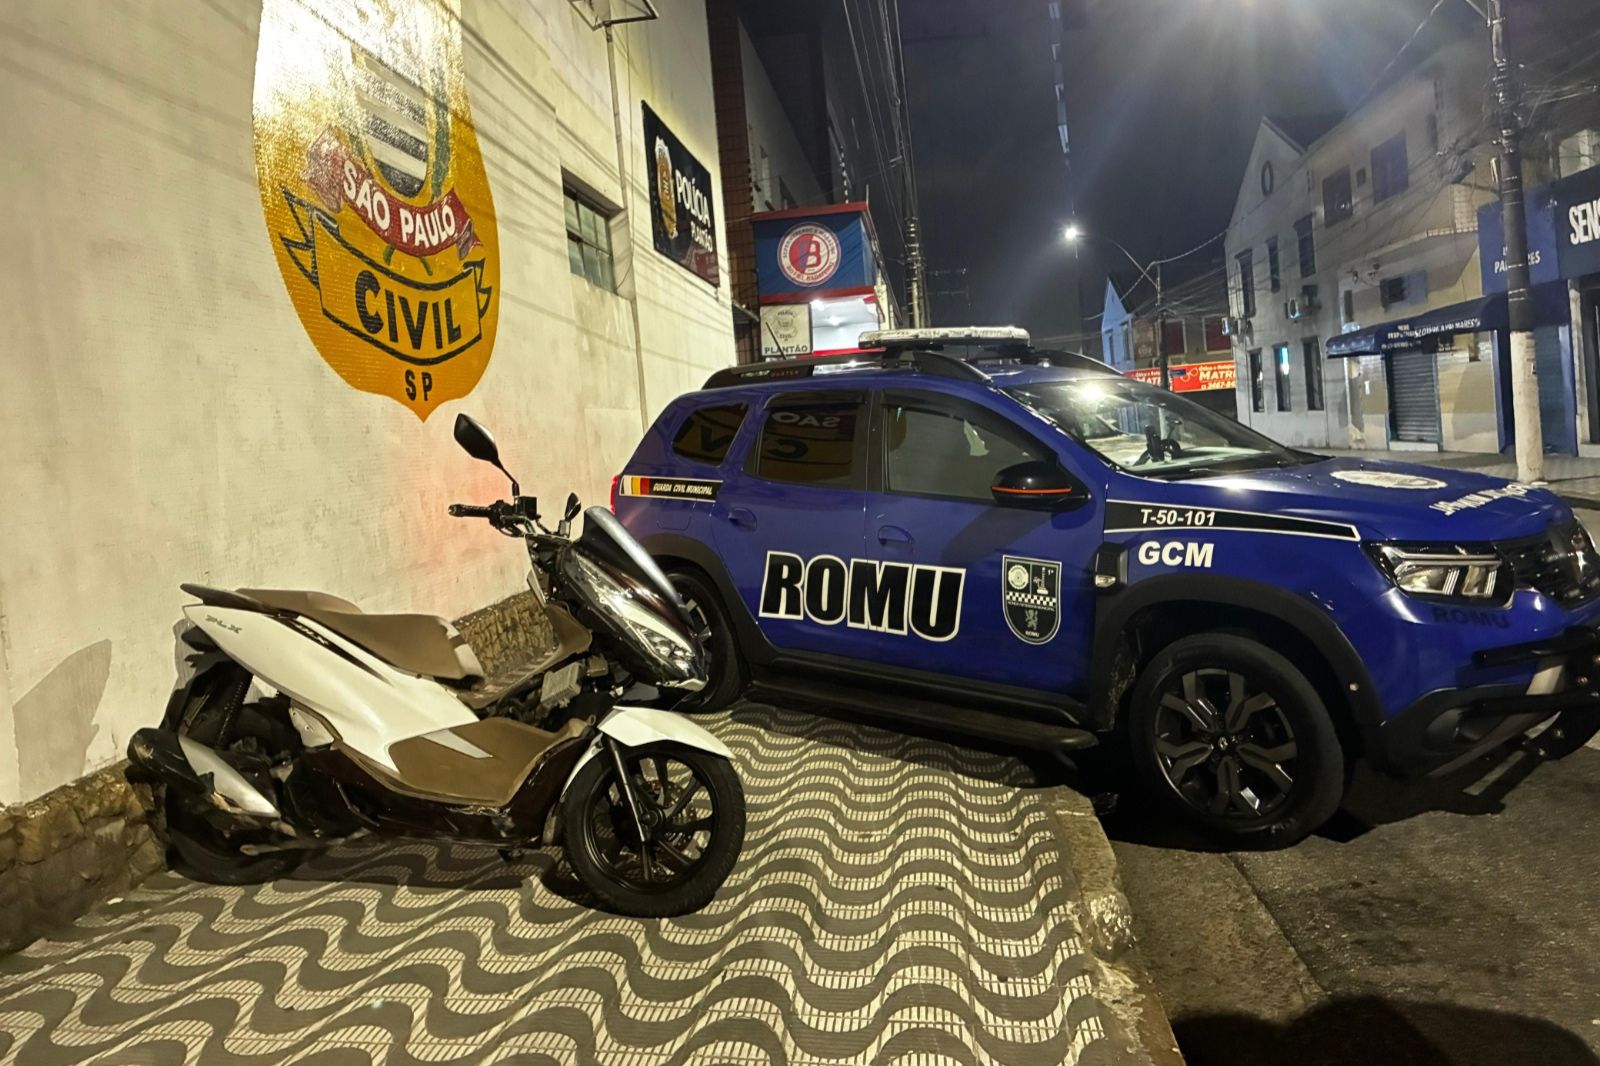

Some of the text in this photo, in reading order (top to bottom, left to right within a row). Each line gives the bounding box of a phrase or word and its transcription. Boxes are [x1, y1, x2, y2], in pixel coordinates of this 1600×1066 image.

[675, 168, 711, 228] POLÍCIA
[400, 200, 456, 249] PAULO
[355, 270, 462, 350] CIVIL
[764, 344, 808, 354] PLANTÃO
[653, 482, 713, 495] GUARDA CIVIL MUNICIPAL
[1140, 508, 1216, 526] T-50-101
[1138, 541, 1215, 568] GCM
[758, 550, 967, 642] ROMU
[1432, 606, 1511, 628] ROMU
